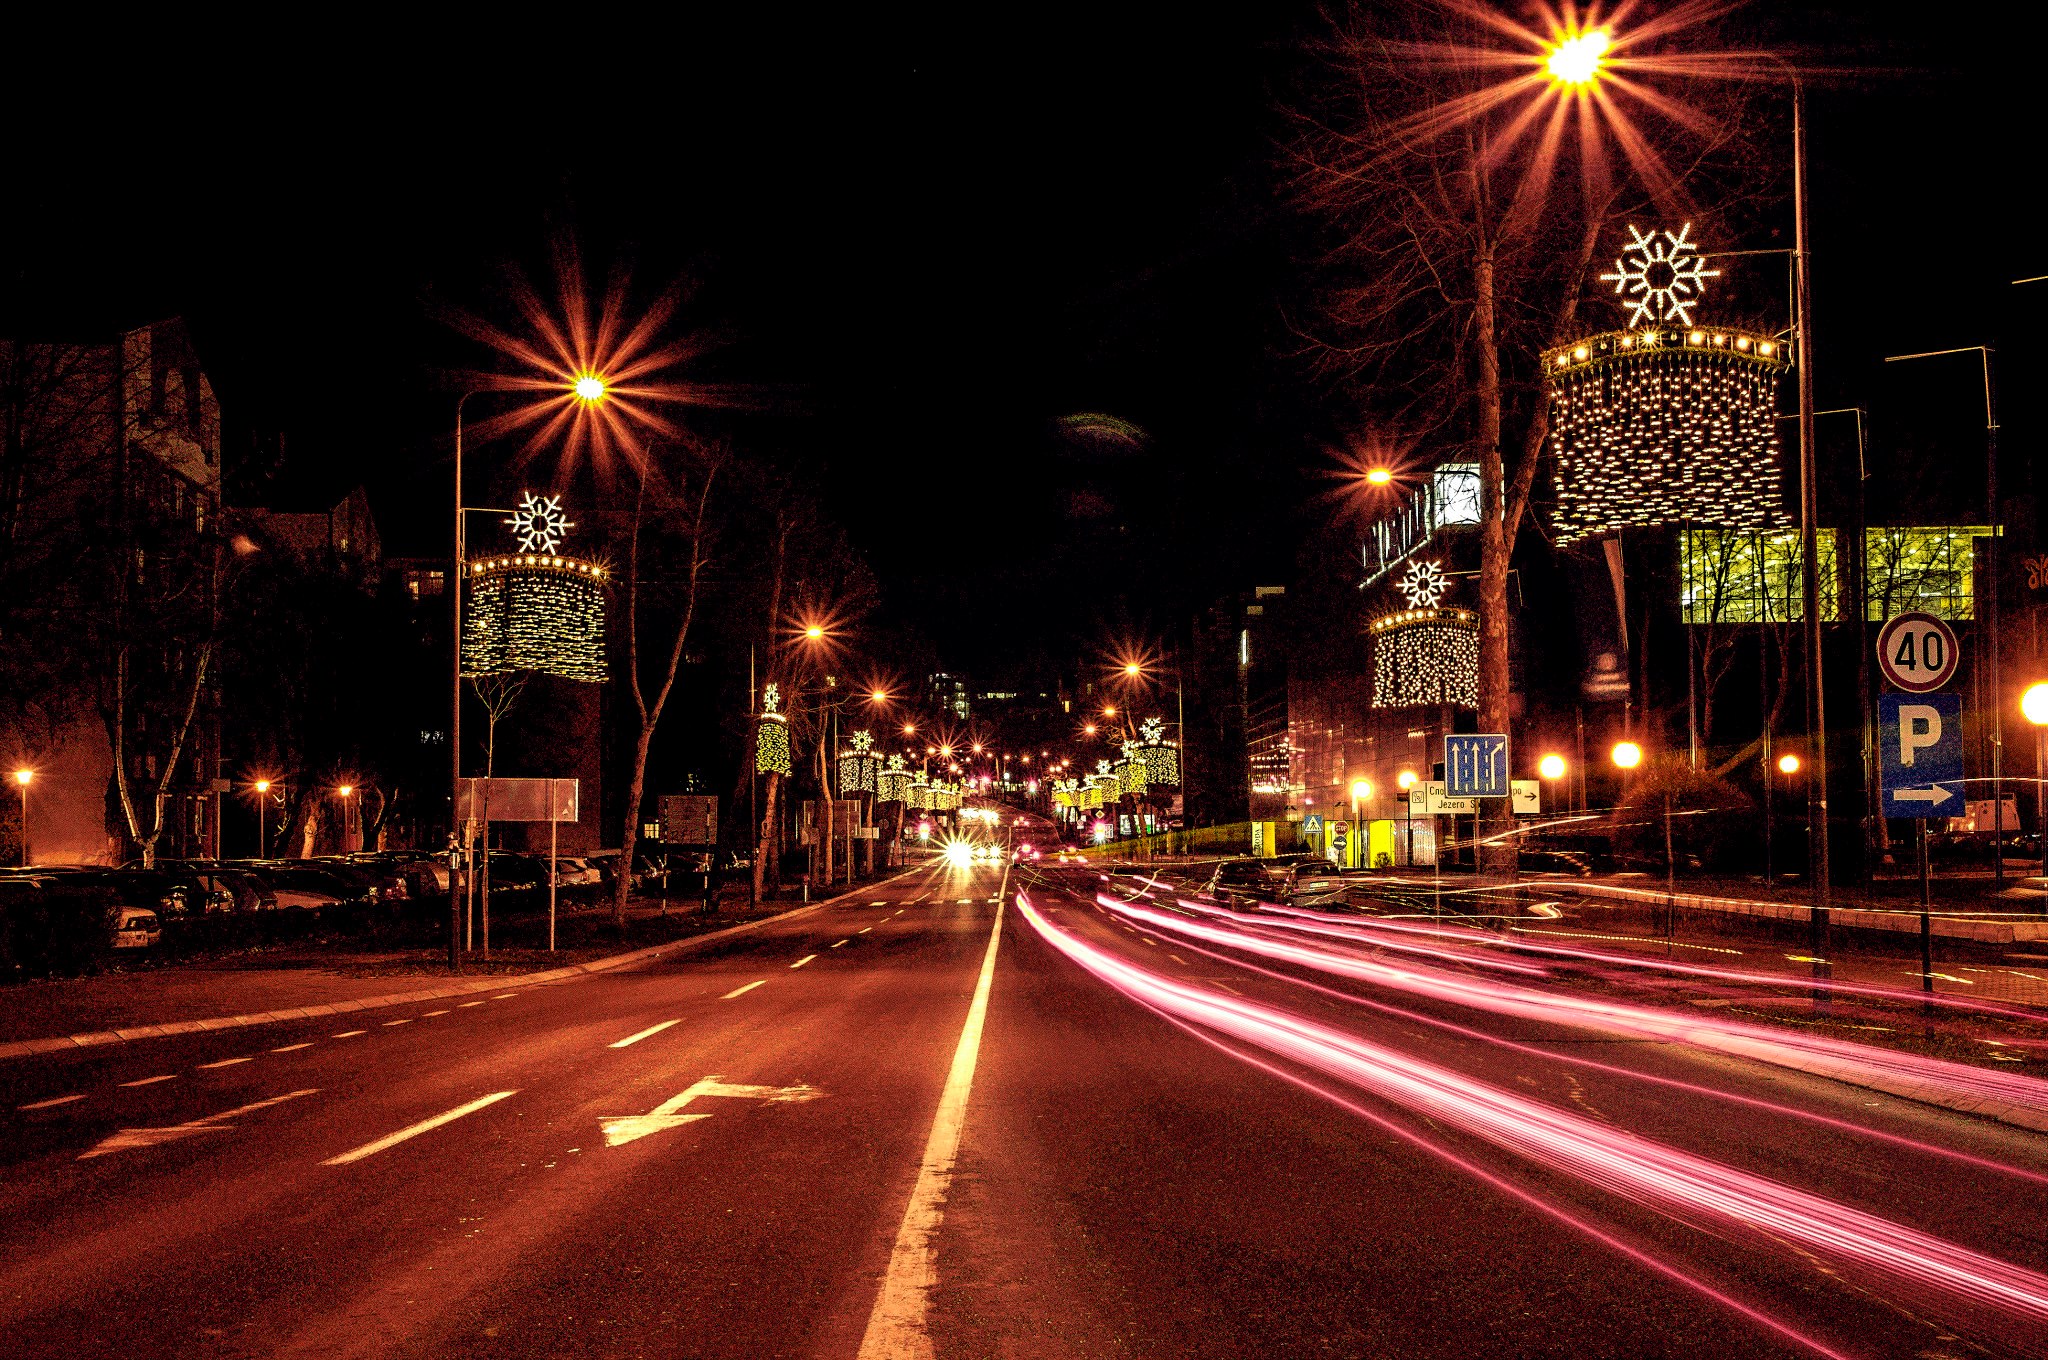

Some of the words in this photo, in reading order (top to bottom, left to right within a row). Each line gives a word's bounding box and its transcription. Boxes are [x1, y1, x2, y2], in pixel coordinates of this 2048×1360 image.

[1895, 631, 1943, 671] 40
[1898, 705, 1942, 766] P
[1438, 800, 1465, 809] Jezero
